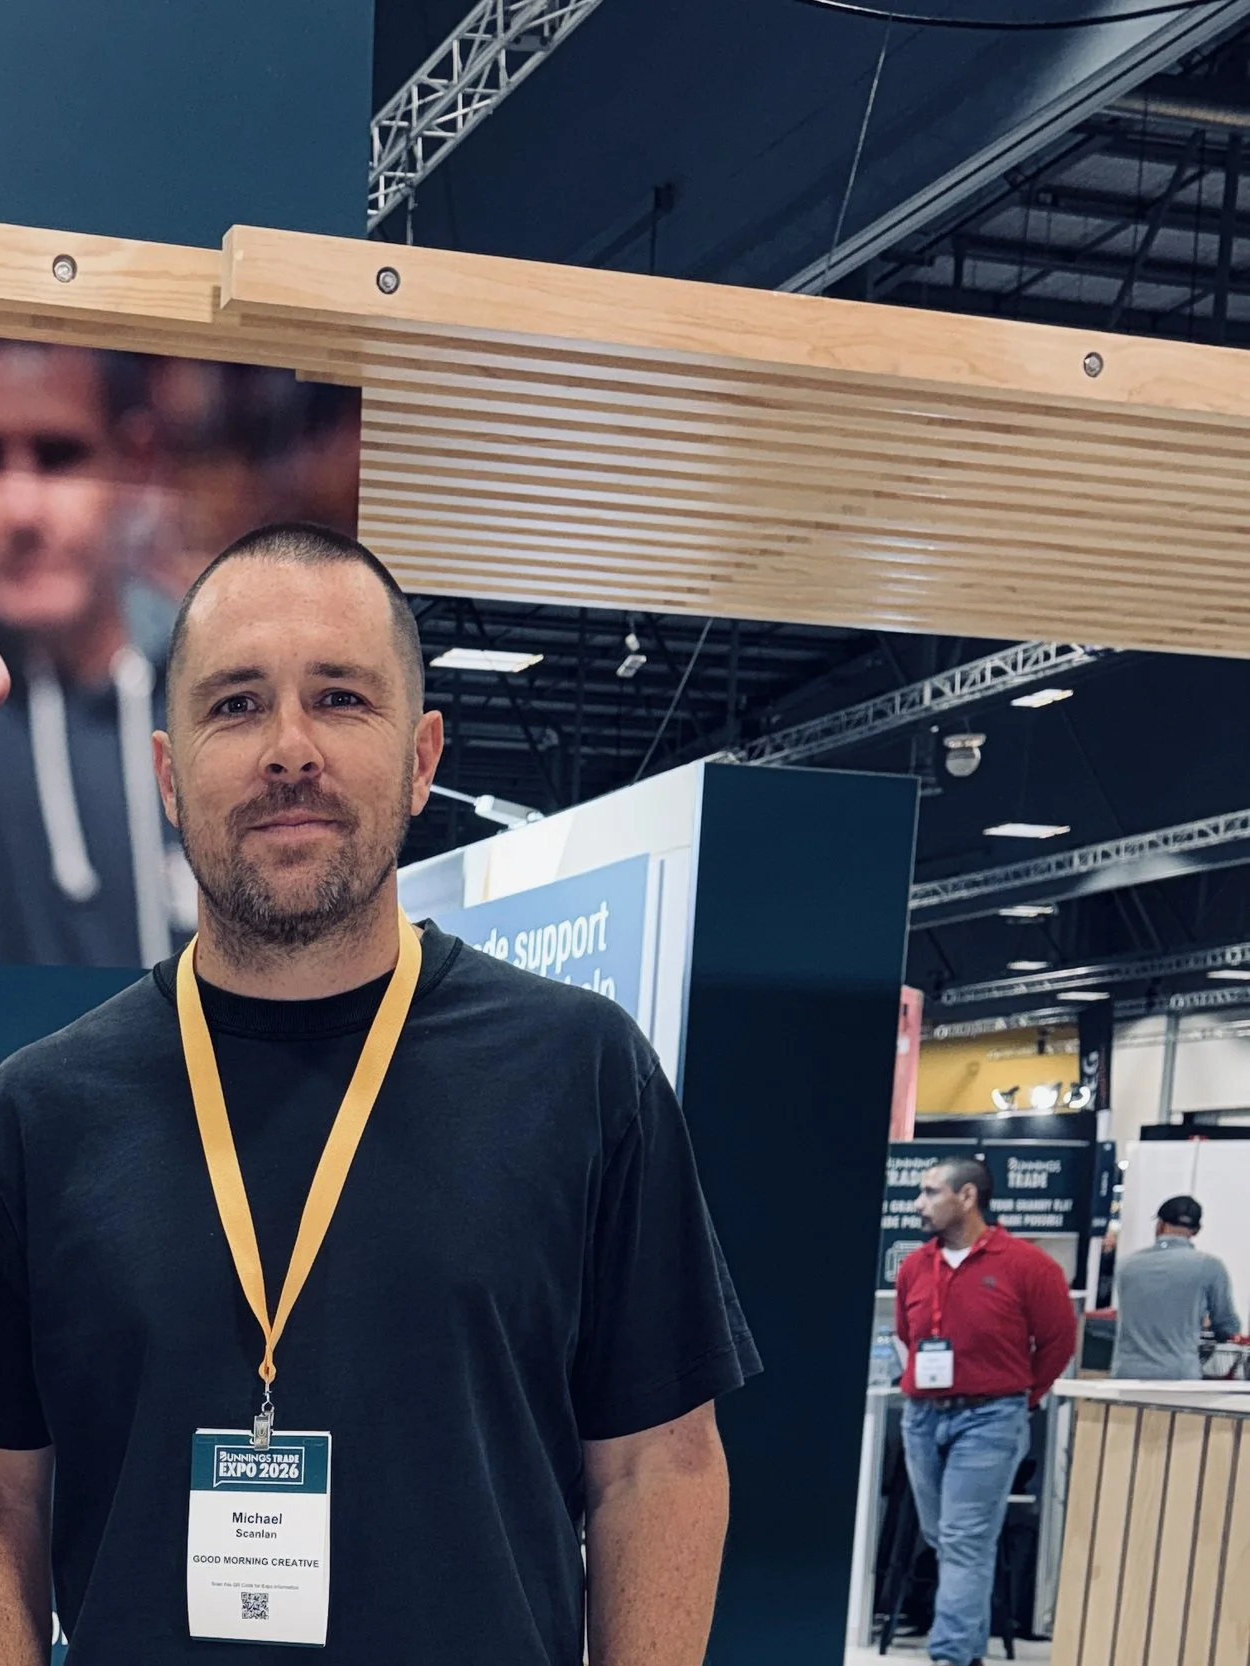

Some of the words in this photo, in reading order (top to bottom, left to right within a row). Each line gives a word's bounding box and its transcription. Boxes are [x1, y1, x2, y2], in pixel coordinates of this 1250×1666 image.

[514, 901, 609, 977] support
[219, 1451, 272, 1463] BUNNINGS
[272, 1454, 300, 1464] TRADE
[218, 1461, 257, 1478] EXPO
[258, 1462, 300, 1479] 2026
[232, 1512, 283, 1525] Michael
[235, 1528, 277, 1539] Scanlan
[193, 1555, 221, 1564] GOOD
[223, 1556, 269, 1566] MORNING
[271, 1558, 320, 1568] CREATIVE
